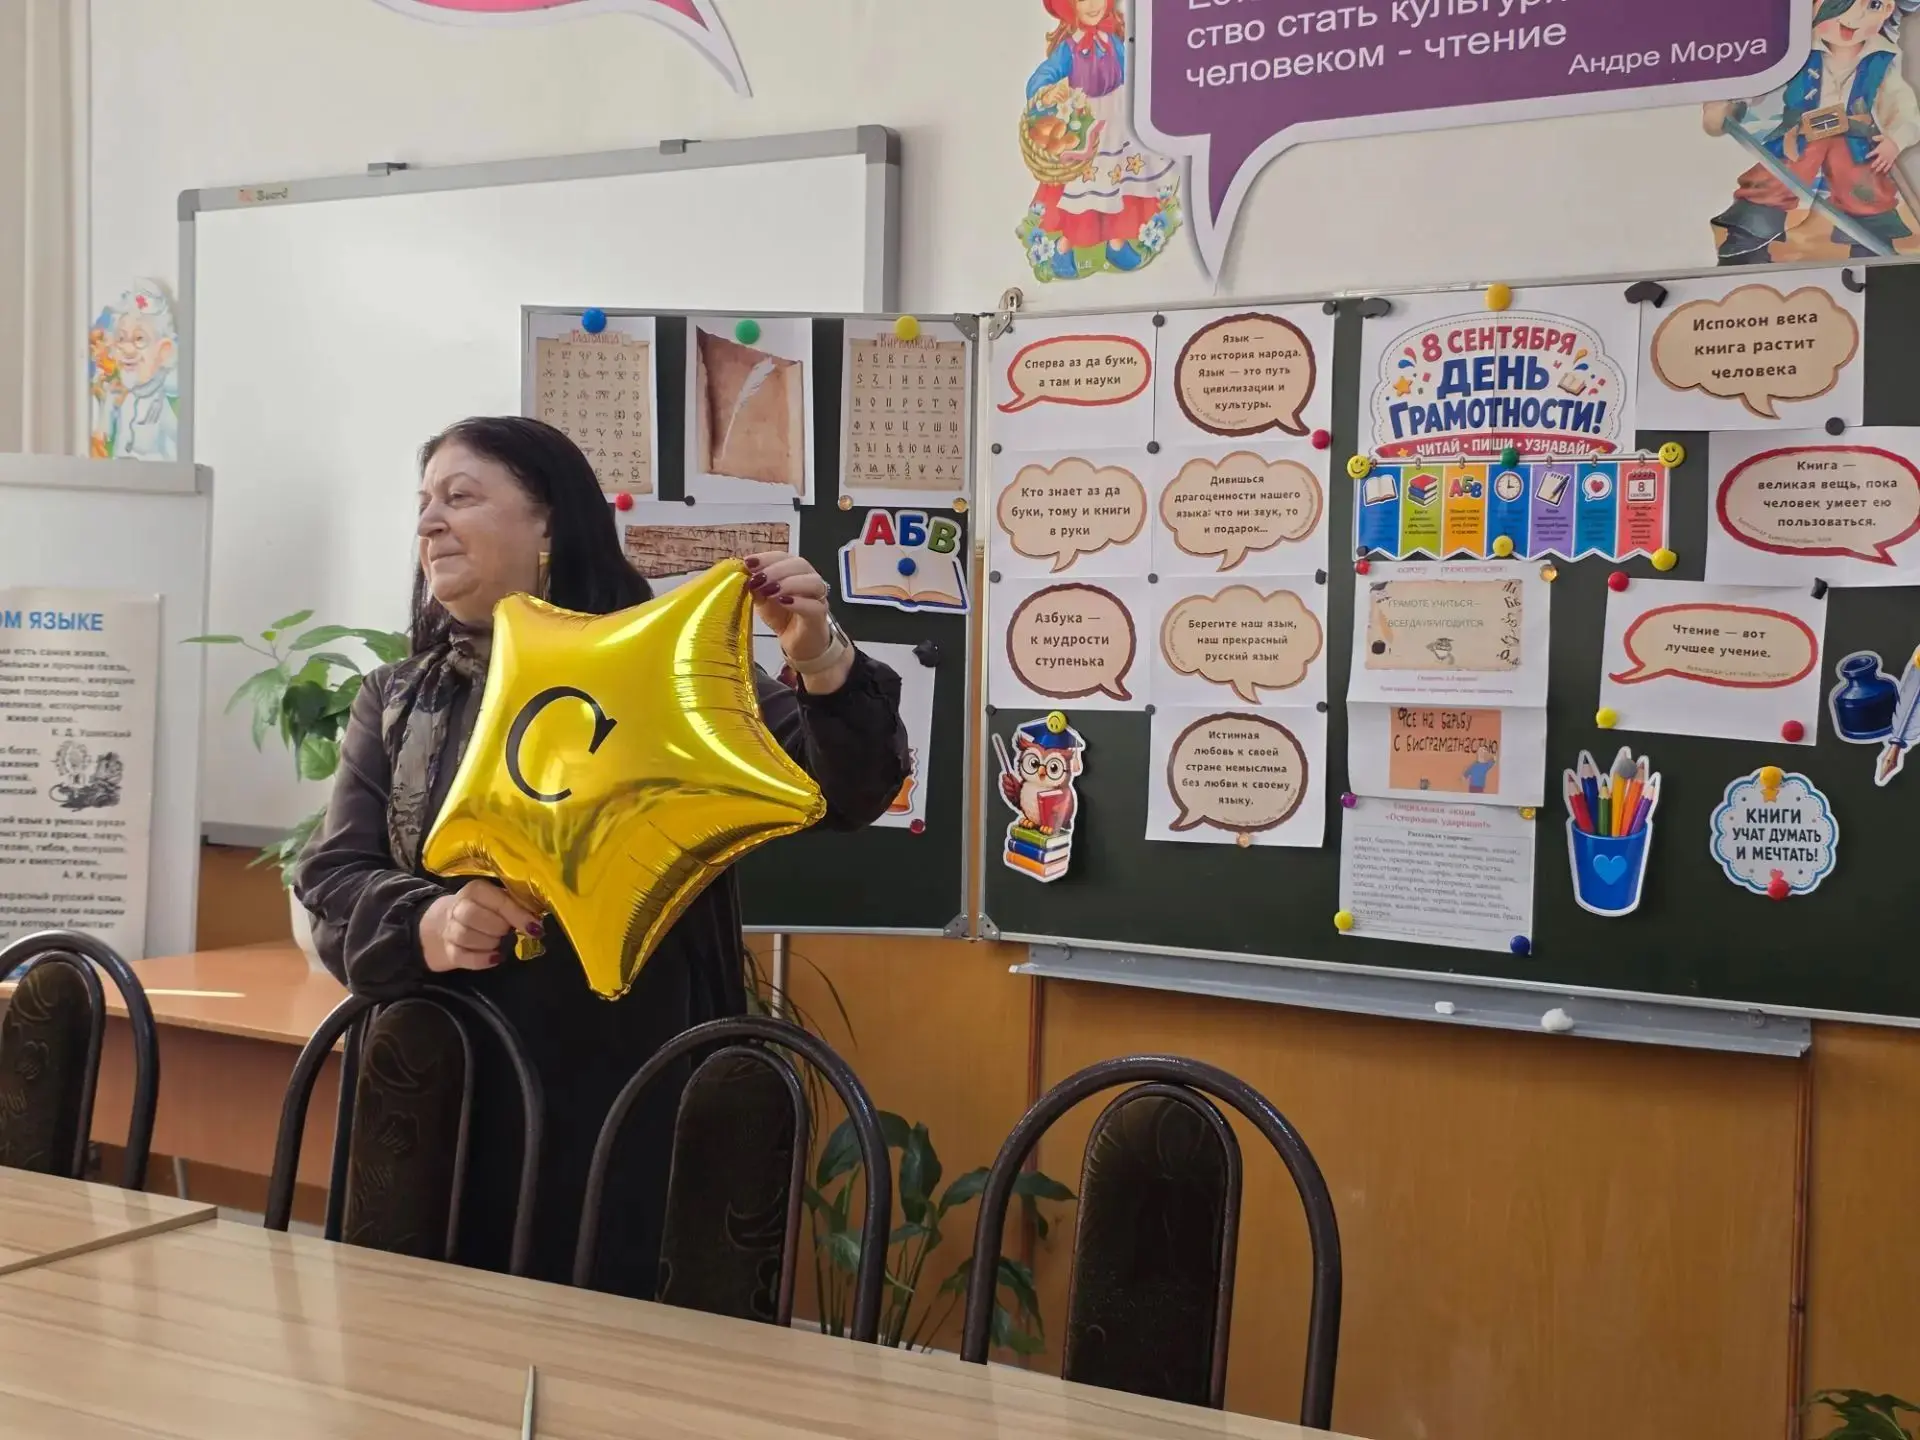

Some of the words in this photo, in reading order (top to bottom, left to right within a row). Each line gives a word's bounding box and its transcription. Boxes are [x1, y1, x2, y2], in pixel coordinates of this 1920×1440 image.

[1186, 20, 1265, 50] ство
[1277, 6, 1378, 38] стать
[1186, 45, 1385, 87] человеком
[1424, 22, 1568, 59] чтение
[1568, 49, 1661, 75] Андре
[1670, 38, 1767, 64] Моруа
[1692, 316, 1769, 331] Испокон
[1776, 312, 1818, 326] века
[1222, 334, 1250, 344] Язык
[1421, 333, 1443, 362] 8
[1447, 325, 1577, 355] СЕНТЯБРЯ
[1694, 343, 1746, 356] книга
[1752, 338, 1816, 355] растит
[1189, 353, 1207, 361] это
[1210, 350, 1255, 361] история
[1258, 349, 1301, 360] народа.
[1024, 358, 1065, 371] Сперва
[1069, 359, 1081, 367] аз
[1085, 358, 1101, 369] да
[1105, 354, 1138, 367] буки,
[1198, 368, 1225, 378] Язык
[1243, 367, 1262, 376] это
[1265, 367, 1291, 377] путь
[1436, 355, 1550, 400] ДЕНЬ
[1711, 364, 1798, 379] человека
[1038, 379, 1045, 388] а
[1049, 377, 1070, 387] там
[1074, 377, 1081, 386] и
[1085, 375, 1121, 387] науки
[1203, 384, 1275, 395] цивилизации
[1278, 383, 1285, 392] и
[1215, 400, 1272, 411] культуры.
[1388, 397, 1607, 439] ГРАМОТНОСТИ!
[1416, 438, 1460, 456] ЧИТАЙ
[1472, 436, 1514, 452] ПИШИ
[1525, 436, 1590, 455] УЗНАВАЙ!
[1797, 460, 1838, 471] Книга
[1210, 476, 1265, 487] Дивишься
[1637, 481, 1645, 493] 8
[1758, 480, 1816, 490] великая
[1820, 480, 1861, 491] вещь,
[1866, 479, 1898, 489] пока
[1021, 487, 1044, 497] Кто
[1048, 487, 1082, 497] знает
[1087, 487, 1100, 496] аз
[1104, 486, 1121, 498] да
[1174, 492, 1257, 504] драгоценности
[1260, 491, 1301, 500] нашего
[1763, 499, 1821, 508] человек
[1826, 499, 1867, 510] умеет
[1872, 498, 1892, 508] ею
[1011, 506, 1044, 519] буки,
[1048, 508, 1078, 519] тому
[1082, 507, 1090, 516] и
[1093, 506, 1131, 516] книги
[1176, 508, 1212, 518] языка:
[1214, 509, 1233, 517] что
[1237, 508, 1250, 517] ни
[1254, 508, 1282, 519] звук,
[1286, 507, 1299, 516] то
[1777, 517, 1877, 528] пользоваться.
[864, 512, 959, 555] АБВ
[1049, 528, 1056, 536] в
[1061, 526, 1090, 538] руки
[1204, 526, 1211, 534] и
[0, 611, 22, 629] М
[29, 611, 104, 631] ЯЗЫКЕ
[1034, 611, 1083, 626] Азбука
[1188, 619, 1237, 630] Берегите
[1241, 619, 1263, 628] наш
[1267, 619, 1297, 630] язык,
[1672, 623, 1720, 637] Чтение
[1742, 629, 1767, 639] вот
[1030, 635, 1038, 645] к
[1043, 635, 1110, 648] мудрости
[1197, 636, 1219, 645] наш
[1222, 635, 1288, 646] прекрасный
[1205, 651, 1248, 663] русский
[1252, 652, 1279, 661] язык
[1664, 643, 1715, 654] лучшее
[1719, 647, 1771, 659] учение.
[1035, 656, 1105, 669] ступенька
[1208, 730, 1260, 740] Истинная
[1193, 746, 1234, 756] любовь
[1237, 748, 1244, 756] к
[1248, 747, 1279, 756] своей
[1185, 763, 1222, 773] стране
[1225, 764, 1288, 773] немыслима
[1182, 777, 1200, 787] без
[1204, 778, 1238, 788] любви
[1252, 780, 1290, 792] своему
[1218, 796, 1254, 807] языку.
[1746, 808, 1801, 824] КНИГИ
[1732, 827, 1765, 841] УЧАТ
[1768, 827, 1822, 843] ДУМАТЬ
[1736, 846, 1746, 860] И
[1752, 846, 1819, 862] МЕЧТАТЬ!
